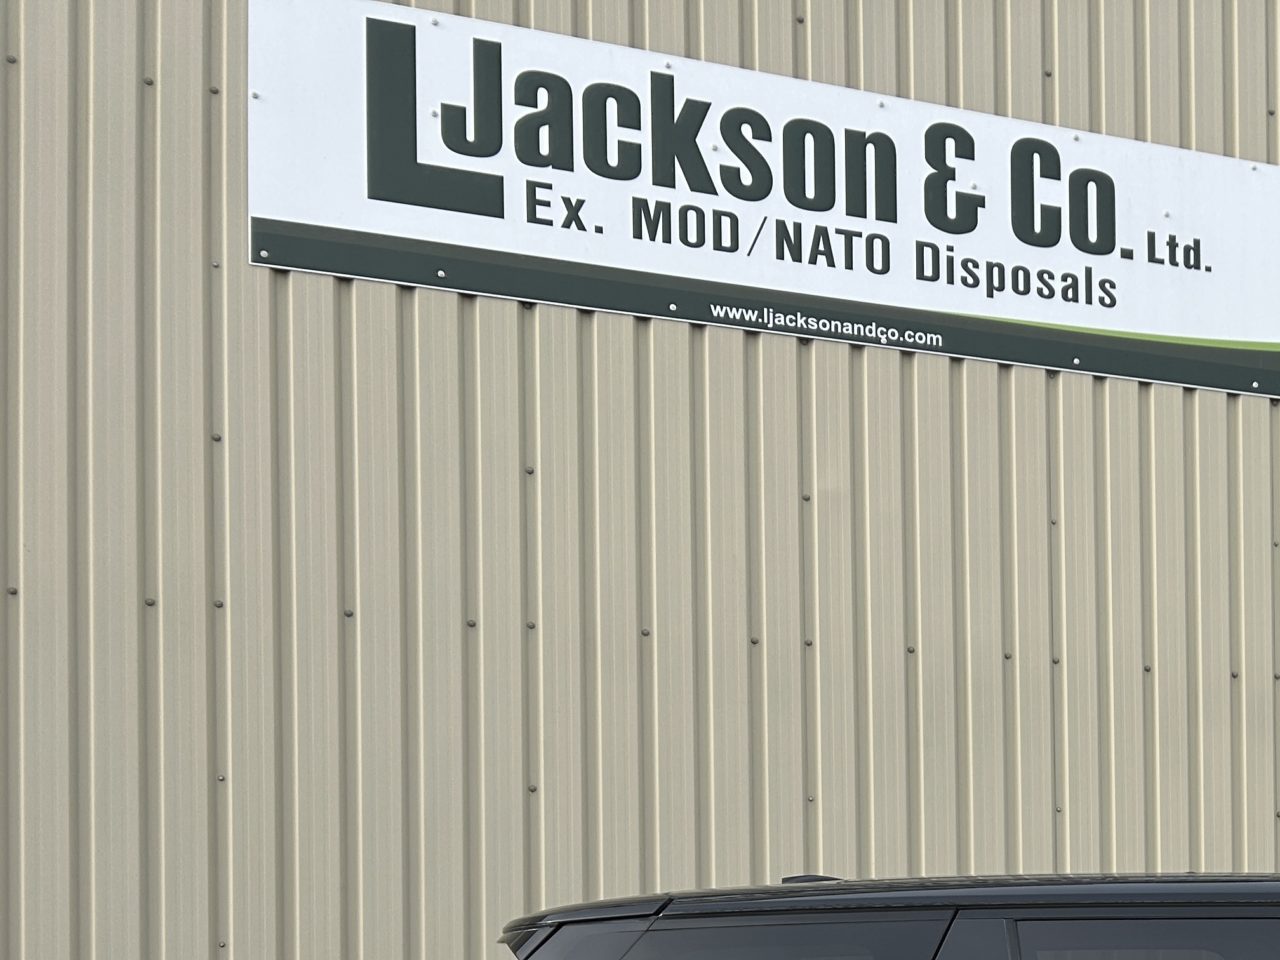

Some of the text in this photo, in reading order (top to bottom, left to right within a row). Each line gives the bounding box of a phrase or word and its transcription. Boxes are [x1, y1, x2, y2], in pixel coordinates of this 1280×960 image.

[526, 179, 1118, 308] Ex. MOD/NATO Disposals
[924, 121, 986, 234] &
[1010, 137, 1134, 260] Co.
[1147, 230, 1213, 273] Ltd.
[709, 303, 943, 347] www.ljacksonandco.com
